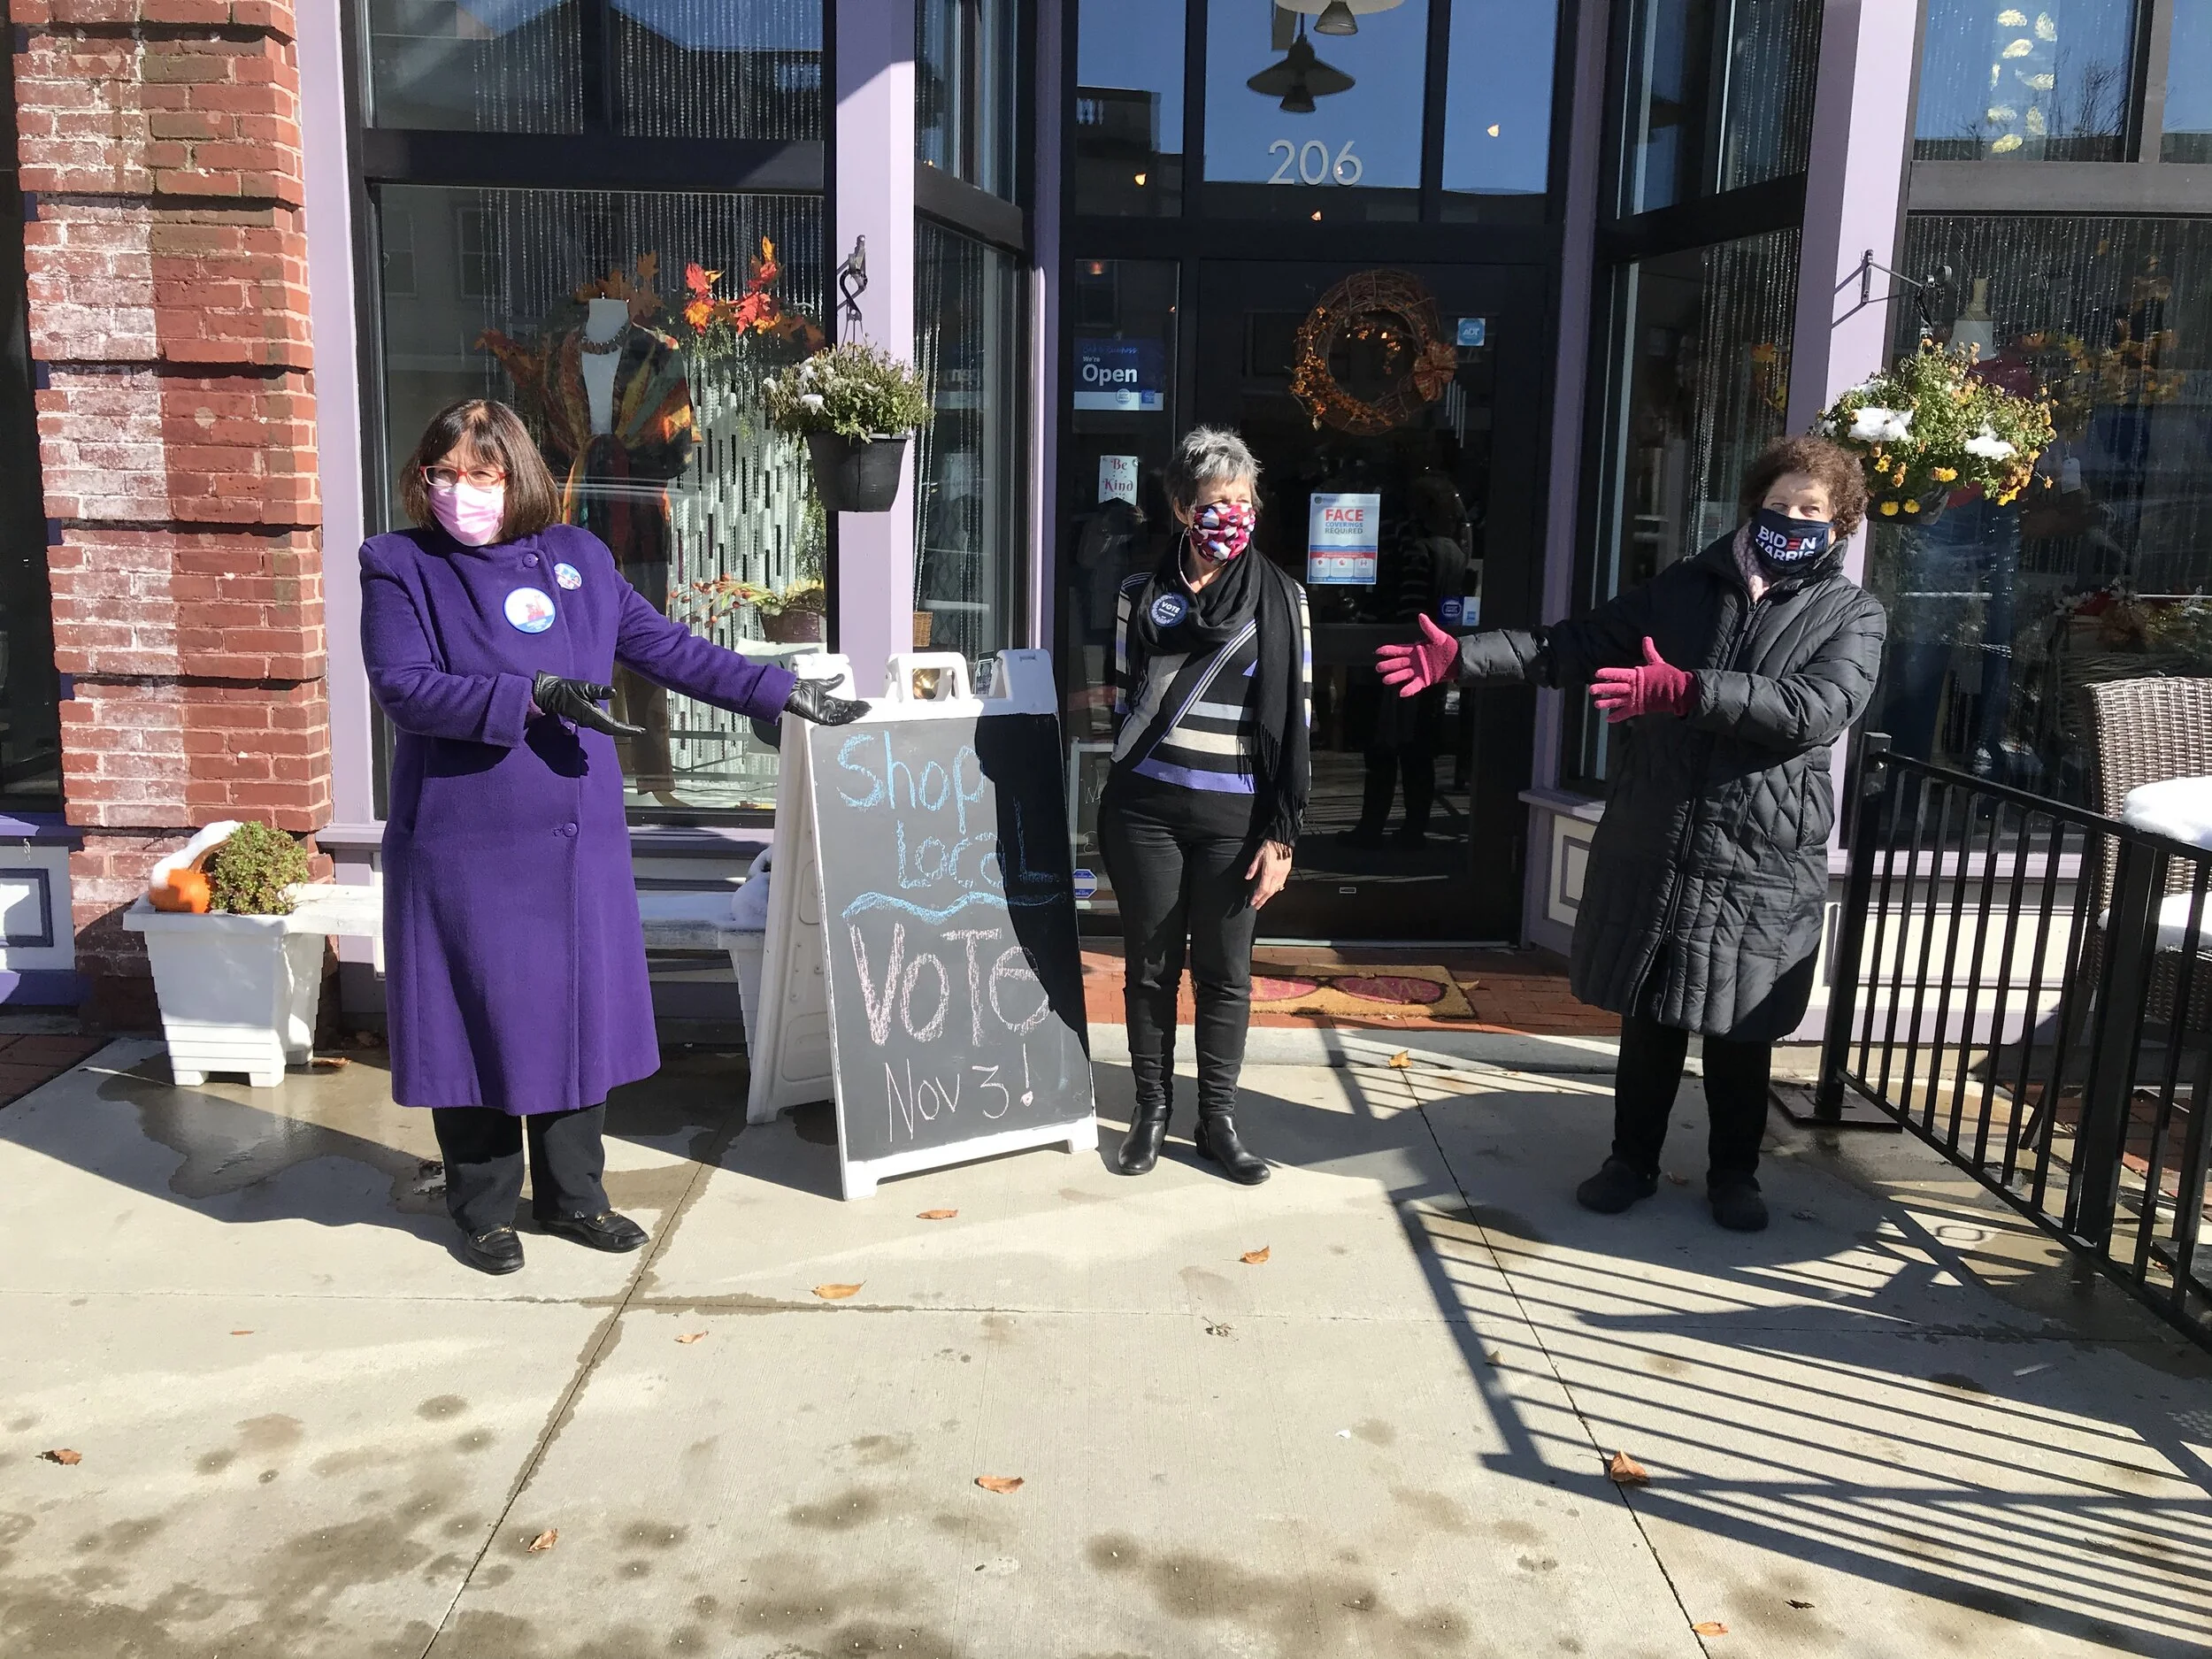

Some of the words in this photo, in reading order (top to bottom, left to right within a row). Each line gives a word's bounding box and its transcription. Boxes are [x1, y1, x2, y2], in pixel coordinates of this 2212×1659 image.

[1267, 139, 1363, 186] 206
[1082, 364, 1138, 386] Open
[1110, 458, 1127, 470] Be
[1103, 479, 1133, 492] Kind
[1325, 509, 1364, 521] FACE
[1757, 526, 1816, 550] BIDEN
[1162, 601, 1180, 613] VOTE
[836, 730, 987, 834] Shop
[885, 1058, 960, 1142] Nov
